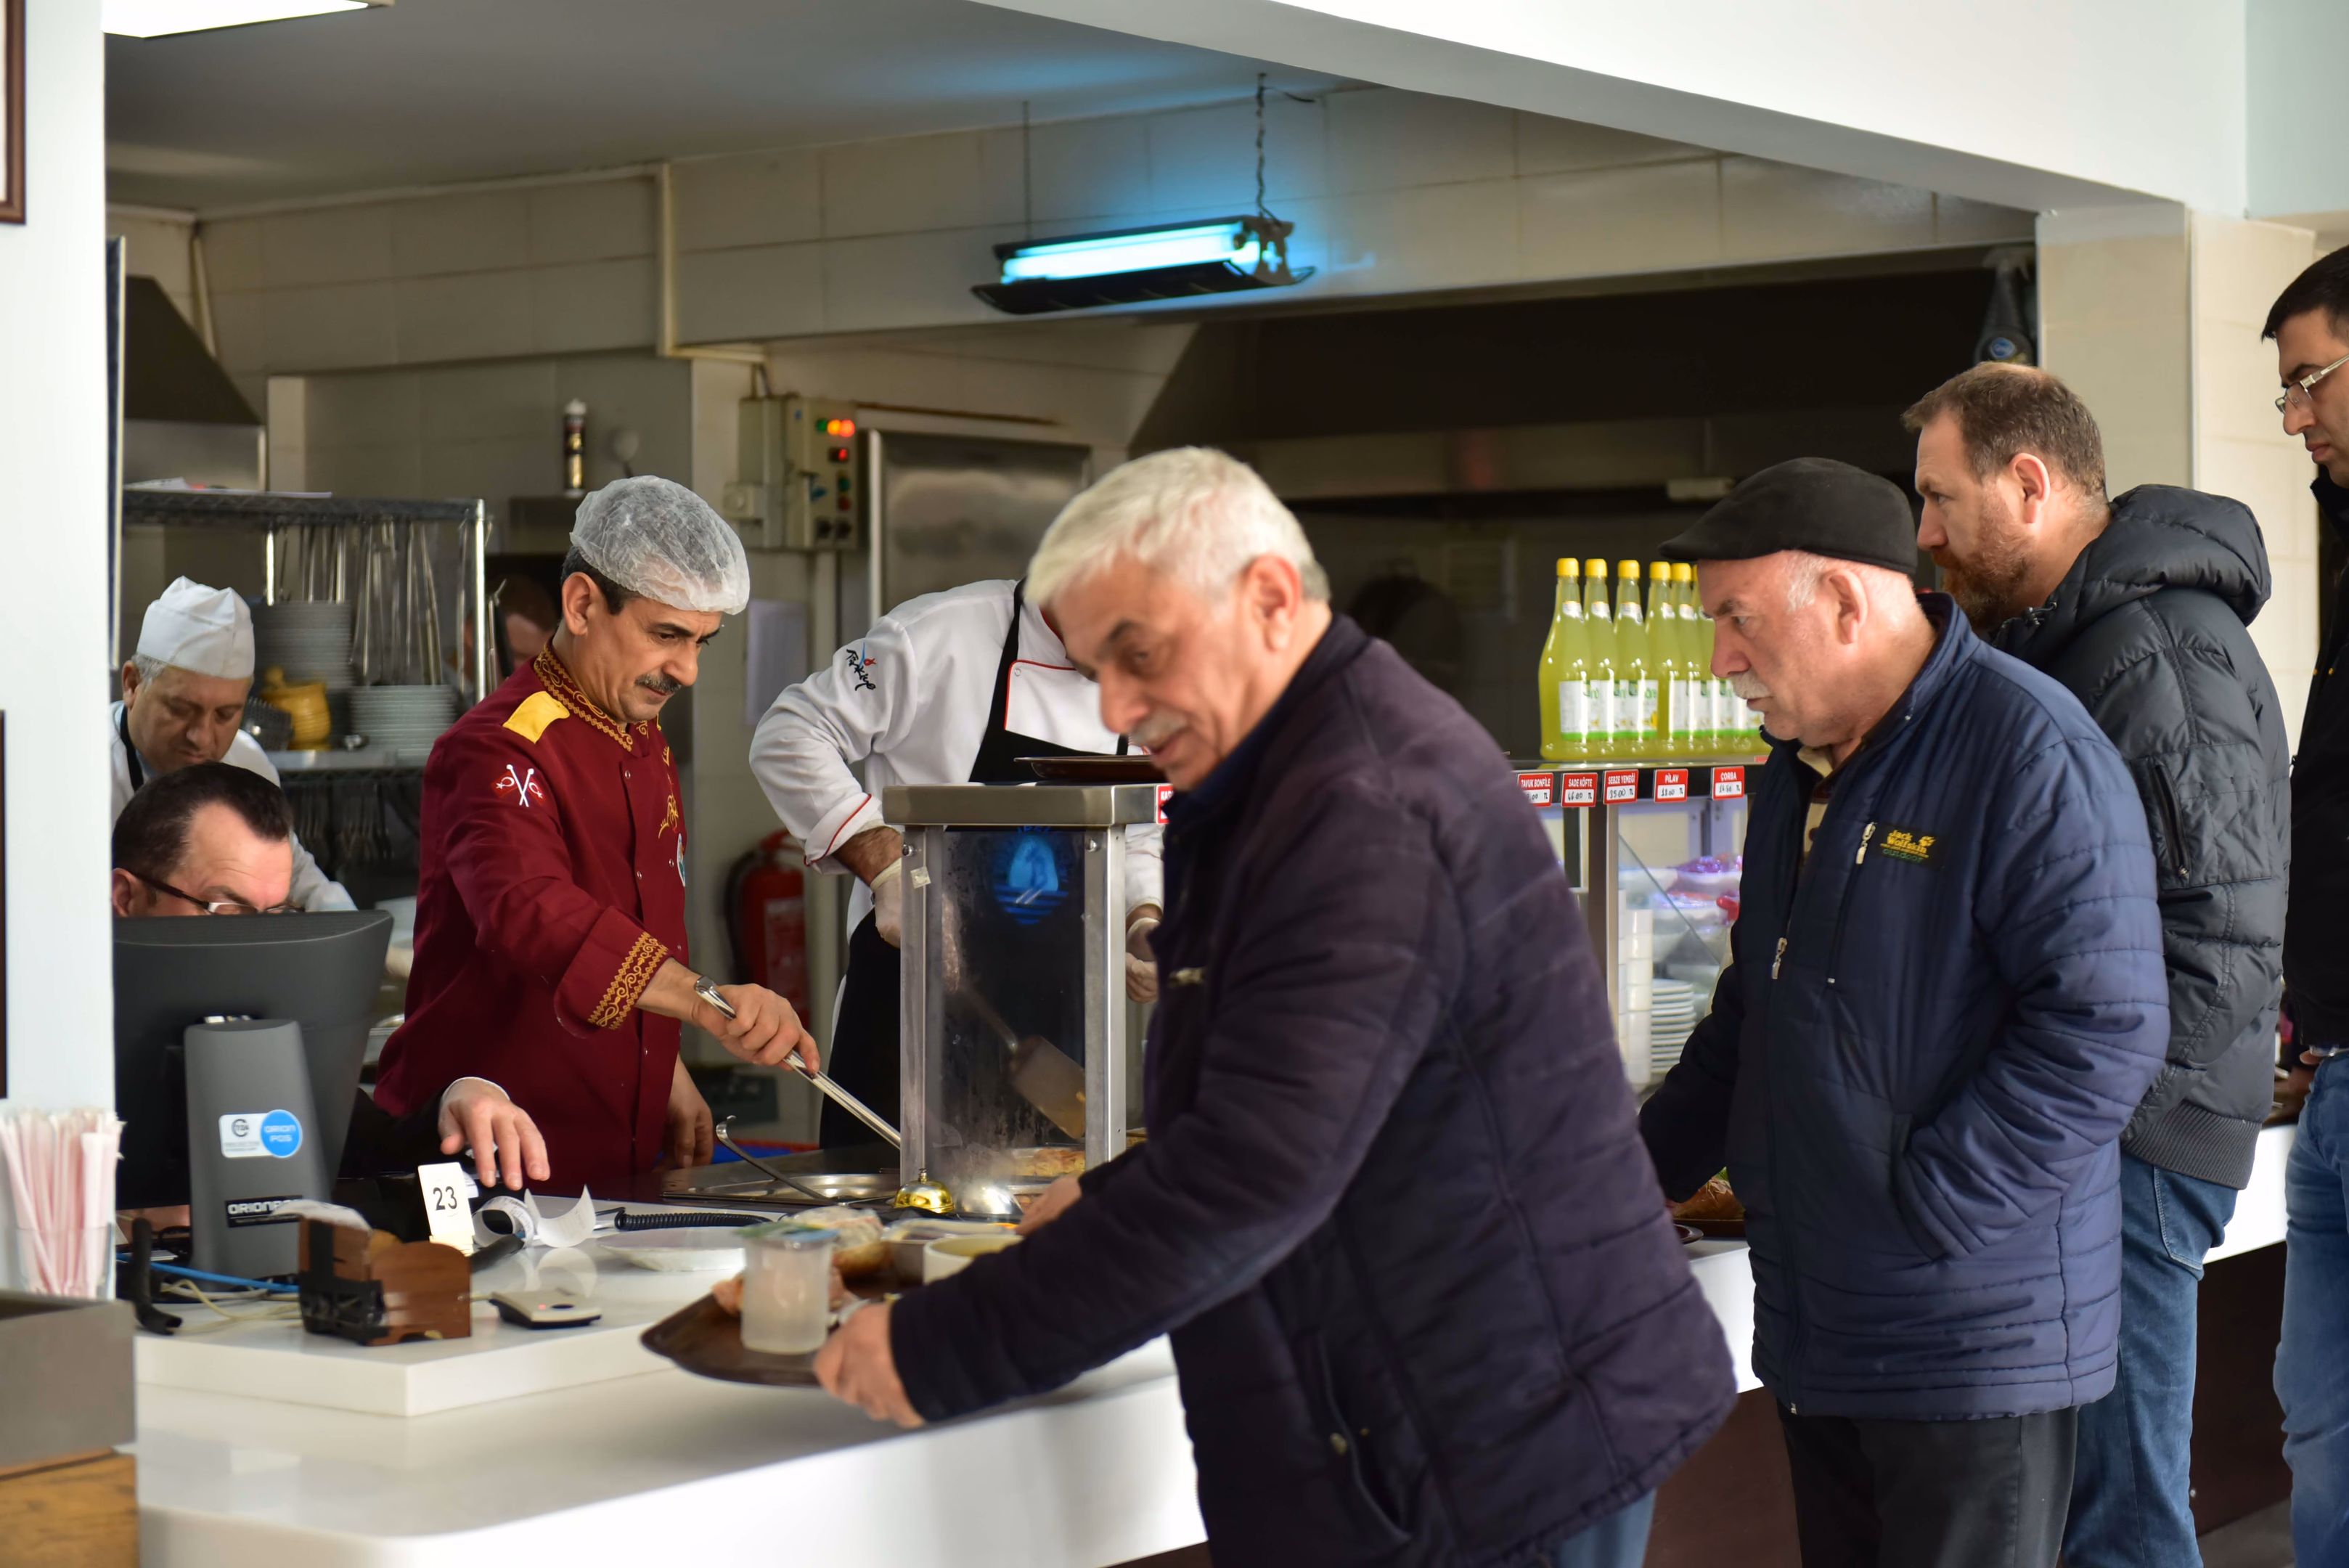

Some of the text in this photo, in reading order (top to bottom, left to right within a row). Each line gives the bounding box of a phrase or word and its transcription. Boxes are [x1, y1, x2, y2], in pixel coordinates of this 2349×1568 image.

[1521, 777, 1551, 788] TAVUK BONFİLE
[1568, 777, 1593, 788] SADE KÖFTE
[1609, 772, 1635, 785] SEBZE YEMEĞİ
[1665, 773, 1679, 783] PİLAV
[1721, 772, 1737, 782] ÇORBA
[1889, 830, 1913, 841] Jack
[1887, 836, 1927, 854] Wolfskin
[433, 1186, 457, 1211] 23
